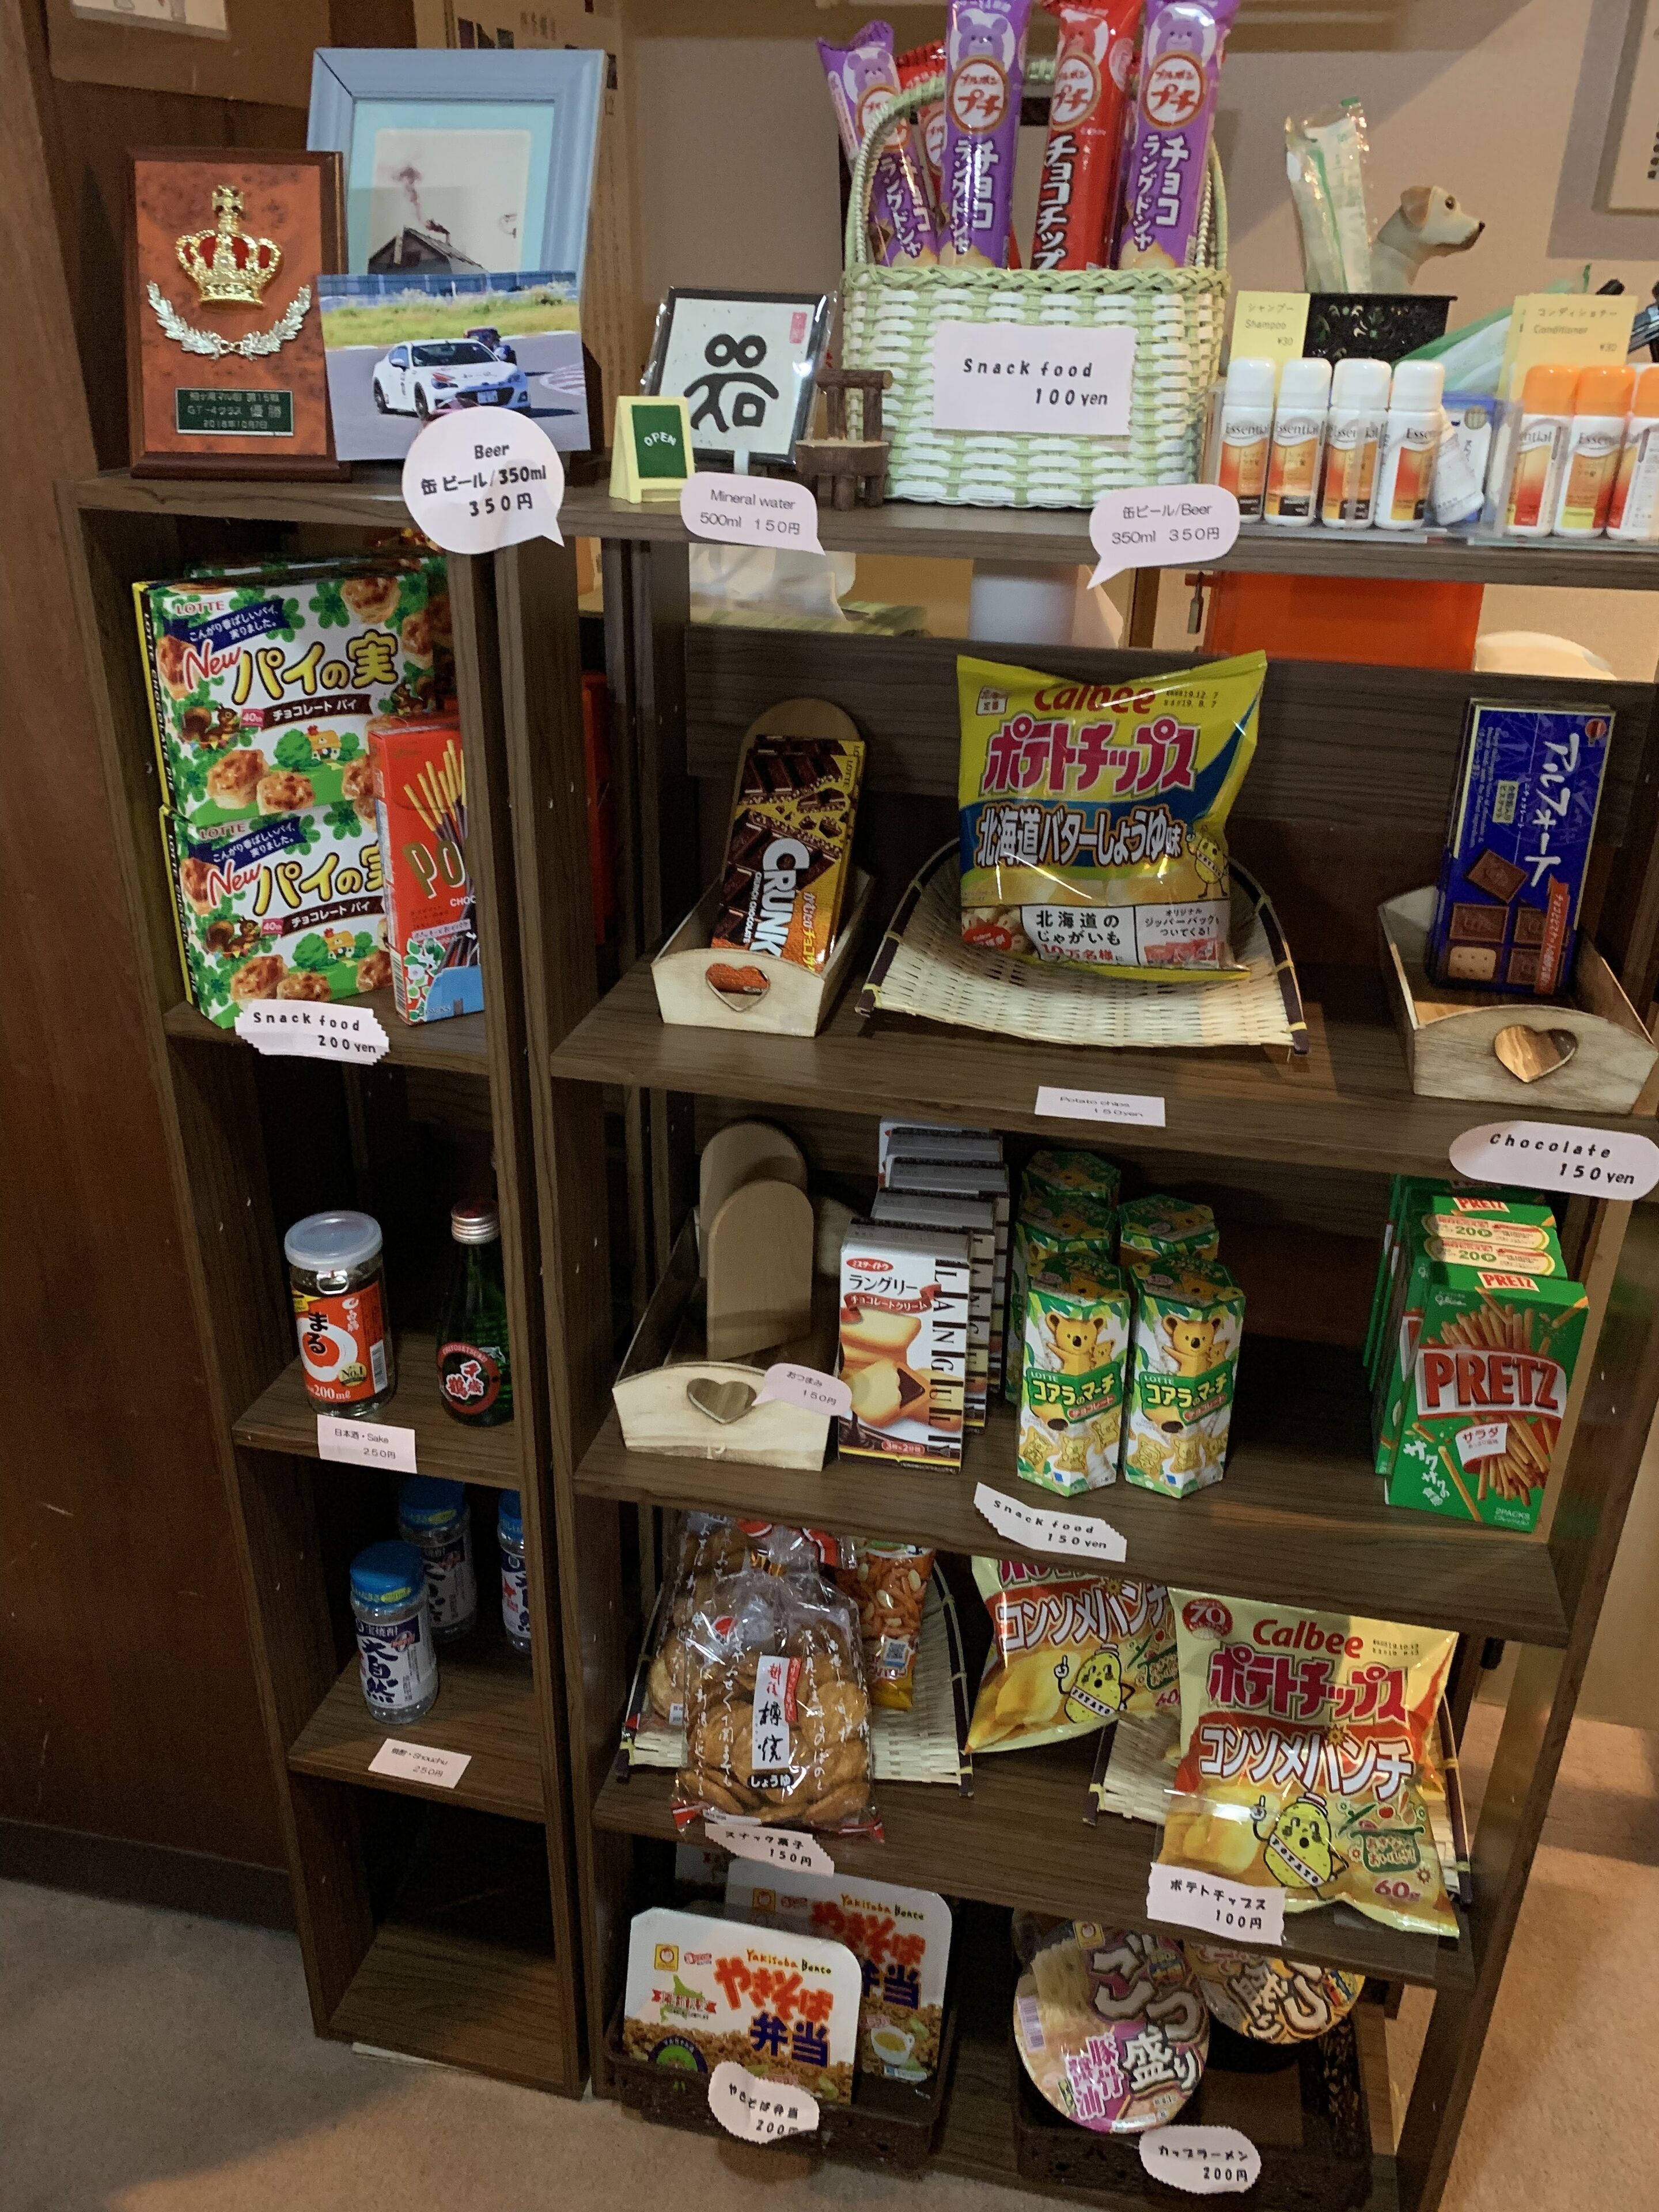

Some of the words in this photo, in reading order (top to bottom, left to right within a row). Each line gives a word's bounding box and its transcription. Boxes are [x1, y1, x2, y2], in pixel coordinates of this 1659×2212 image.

[957, 89, 1002, 119] プチ
[1054, 84, 1089, 111] プチ
[1151, 84, 1197, 111] プチ
[972, 140, 999, 229] チョコ
[1133, 134, 1160, 251] ラングドシャ
[1156, 135, 1190, 226] チョコ
[1033, 135, 1077, 270] チョコチップ
[1245, 319, 1287, 331] Shampoo
[963, 358, 1032, 377] Snack
[1040, 362, 1094, 378] food
[1035, 388, 1108, 407] 100yen
[643, 431, 677, 448] OPEN
[474, 444, 510, 460] Beer
[468, 492, 533, 517] 350円
[710, 489, 756, 506] Mineral
[759, 497, 797, 510] water
[700, 512, 742, 529] 500ml
[753, 518, 801, 536] 150円
[1112, 529, 1156, 545] 350ml
[1168, 527, 1220, 543] 350円
[176, 600, 225, 615] LOTTE
[184, 640, 241, 691] New
[232, 628, 399, 706] パイの実
[272, 700, 333, 722] チョコレート
[336, 698, 358, 712] パイ
[984, 716, 1200, 795] ポテトチップス
[842, 759, 855, 789] LOTTE
[1524, 732, 1580, 888] アルフォート
[199, 823, 247, 839] LOTTE
[978, 806, 1182, 866] 北海道バターしょうゆ味
[208, 861, 262, 907] New
[748, 838, 811, 957] CRUNK
[291, 904, 347, 929] チョコレート
[350, 900, 370, 914] パイ
[1036, 910, 1120, 929] 北海道の
[1037, 929, 1121, 946] じゃがいも
[253, 1012, 312, 1026] Snack
[319, 1015, 361, 1032] food
[317, 1035, 377, 1055] 200yen
[1059, 1096, 1098, 1106] Potato
[1100, 1099, 1131, 1108] chips
[1490, 1132, 1611, 1159] Chocolate
[1559, 1162, 1635, 1185] 150yen
[1458, 1198, 1506, 1210] PRETZ
[849, 1274, 918, 1296] ラングリー
[1482, 1274, 1535, 1289] PRETZ
[850, 1295, 928, 1312] チョコレートクリーム
[307, 1311, 329, 1355] まる
[342, 1365, 363, 1378] No.1
[786, 1371, 823, 1388] おつまみ
[1031, 1371, 1059, 1382] LOTTE
[1422, 1350, 1559, 1410] PRETZ
[803, 1389, 837, 1406] 150円
[1033, 1373, 1115, 1406] コアラのマーチ
[1146, 1372, 1228, 1408] コアラのマーチ
[1462, 1426, 1499, 1444] サラダ
[992, 1499, 1044, 1528] Snack
[1052, 1519, 1094, 1535] food
[1047, 1532, 1108, 1551] 150yen
[998, 1582, 1167, 1653] コンソメパンチ
[1190, 1605, 1225, 1628] 70
[1252, 1618, 1364, 1660] Calbee
[1211, 1646, 1408, 1722] ポテトチップス
[1154, 1689, 1181, 1707] 60
[1200, 1728, 1415, 1801] コンソメパンチ
[750, 1773, 791, 1789] しょうゆ
[769, 1847, 812, 1868] 150円
[1271, 1838, 1319, 1884] POTATO
[1169, 1878, 1266, 1912] ポテトチップス
[1215, 1909, 1263, 1930] 100円
[713, 1956, 834, 2022] やきそば
[749, 2010, 830, 2069] 弁当
[1158, 2144, 1248, 2161] カップラーメン
[1203, 2166, 1248, 2183] 200円
